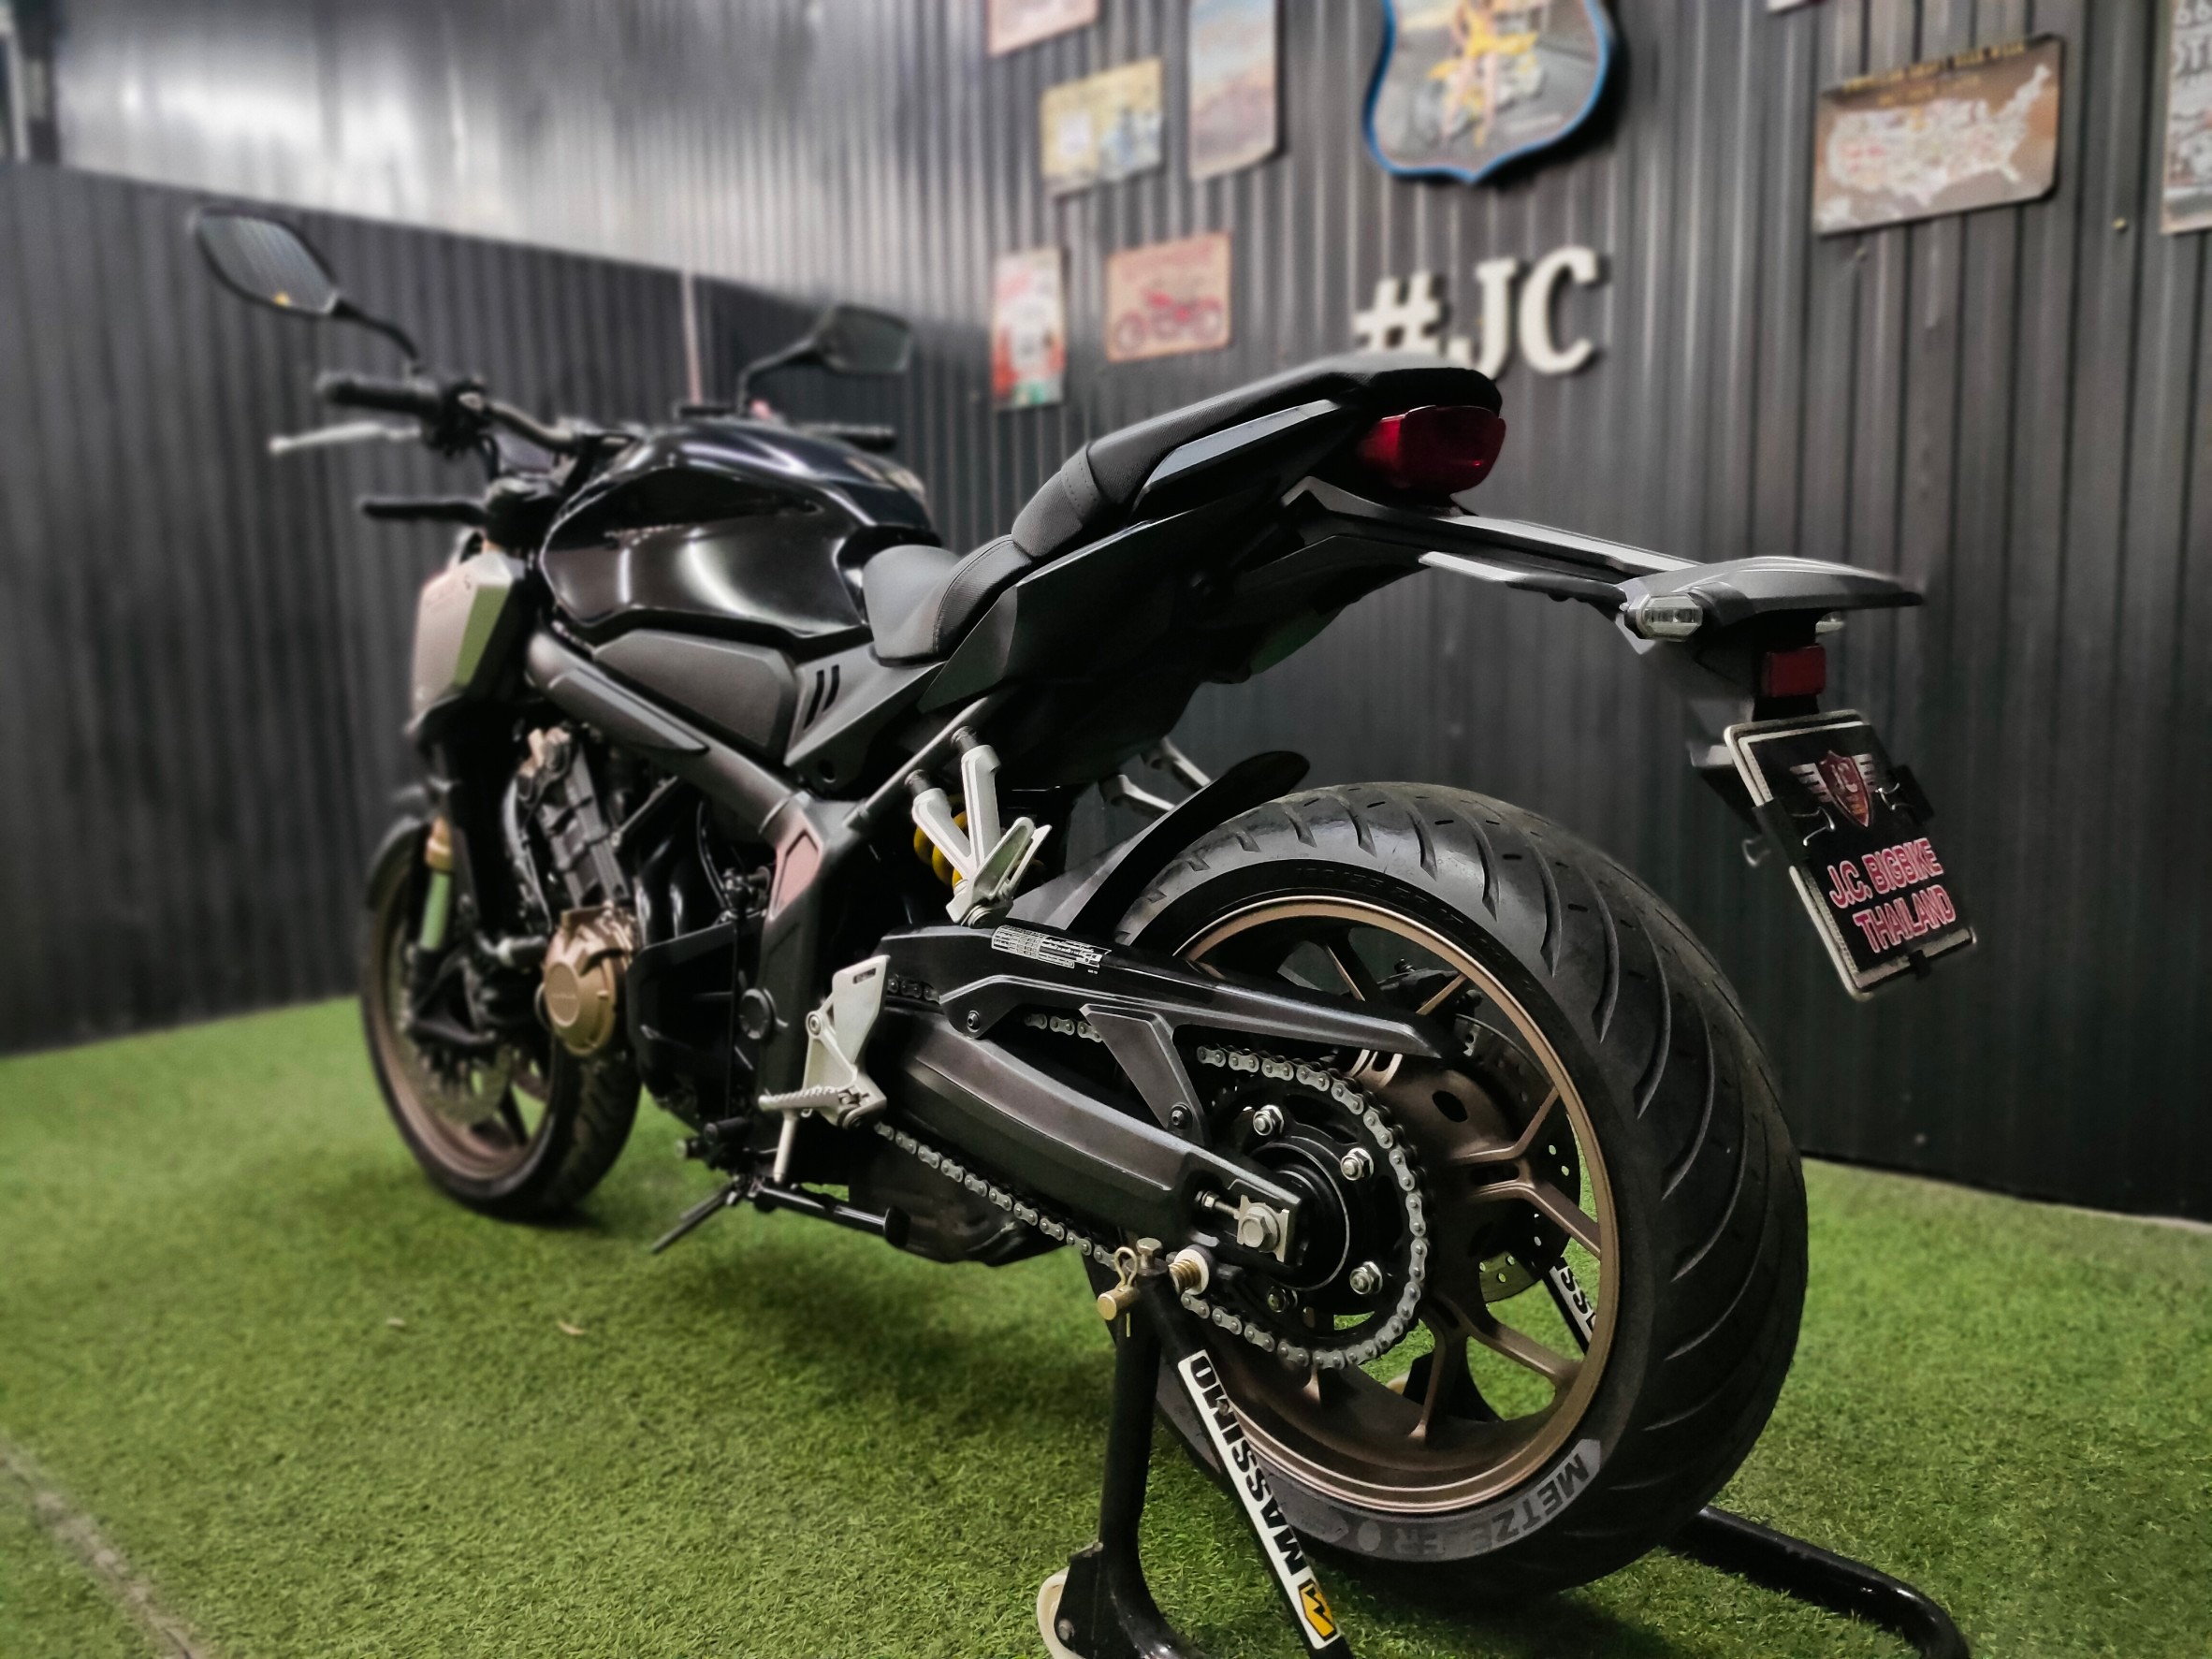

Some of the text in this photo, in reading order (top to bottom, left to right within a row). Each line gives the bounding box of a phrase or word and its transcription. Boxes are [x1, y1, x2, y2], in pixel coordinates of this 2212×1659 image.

[1827, 837, 1944, 909] J.C. BIGBIKE
[1853, 884, 1957, 953] THAILAND
[1190, 1355, 1308, 1577] MASSIMO
